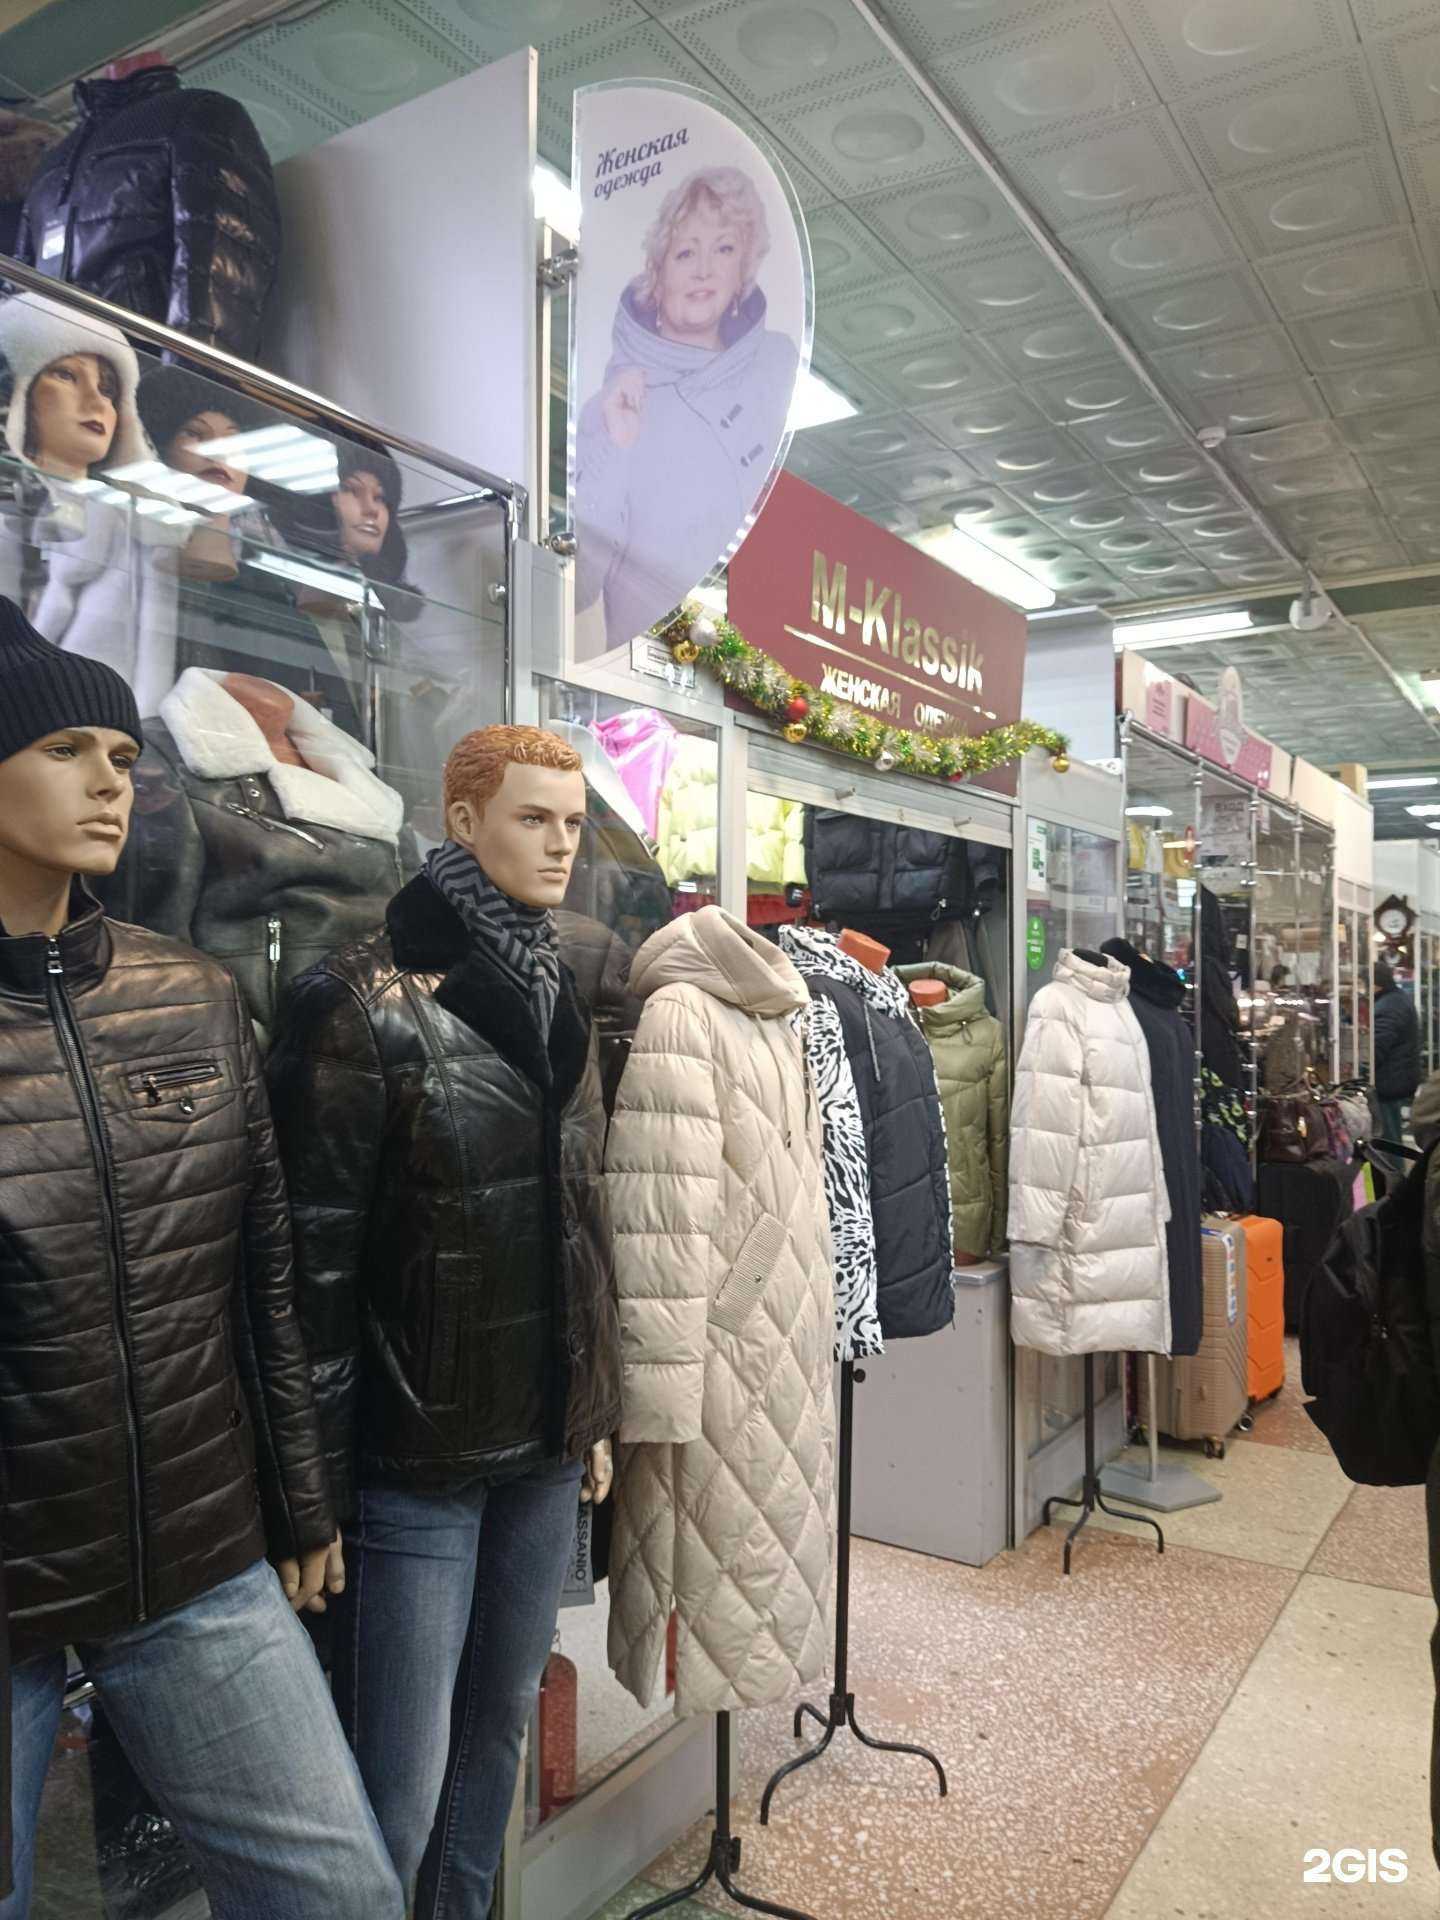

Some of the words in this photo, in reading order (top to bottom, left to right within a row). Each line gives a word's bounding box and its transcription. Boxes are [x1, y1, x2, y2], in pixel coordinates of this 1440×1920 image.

[594, 159, 663, 200] одежда
[595, 127, 690, 178] Женская
[811, 549, 985, 697] M-Klassik
[820, 662, 902, 719] ЖЕНСКАЯ
[575, 1505, 588, 1581] ASSANIO
